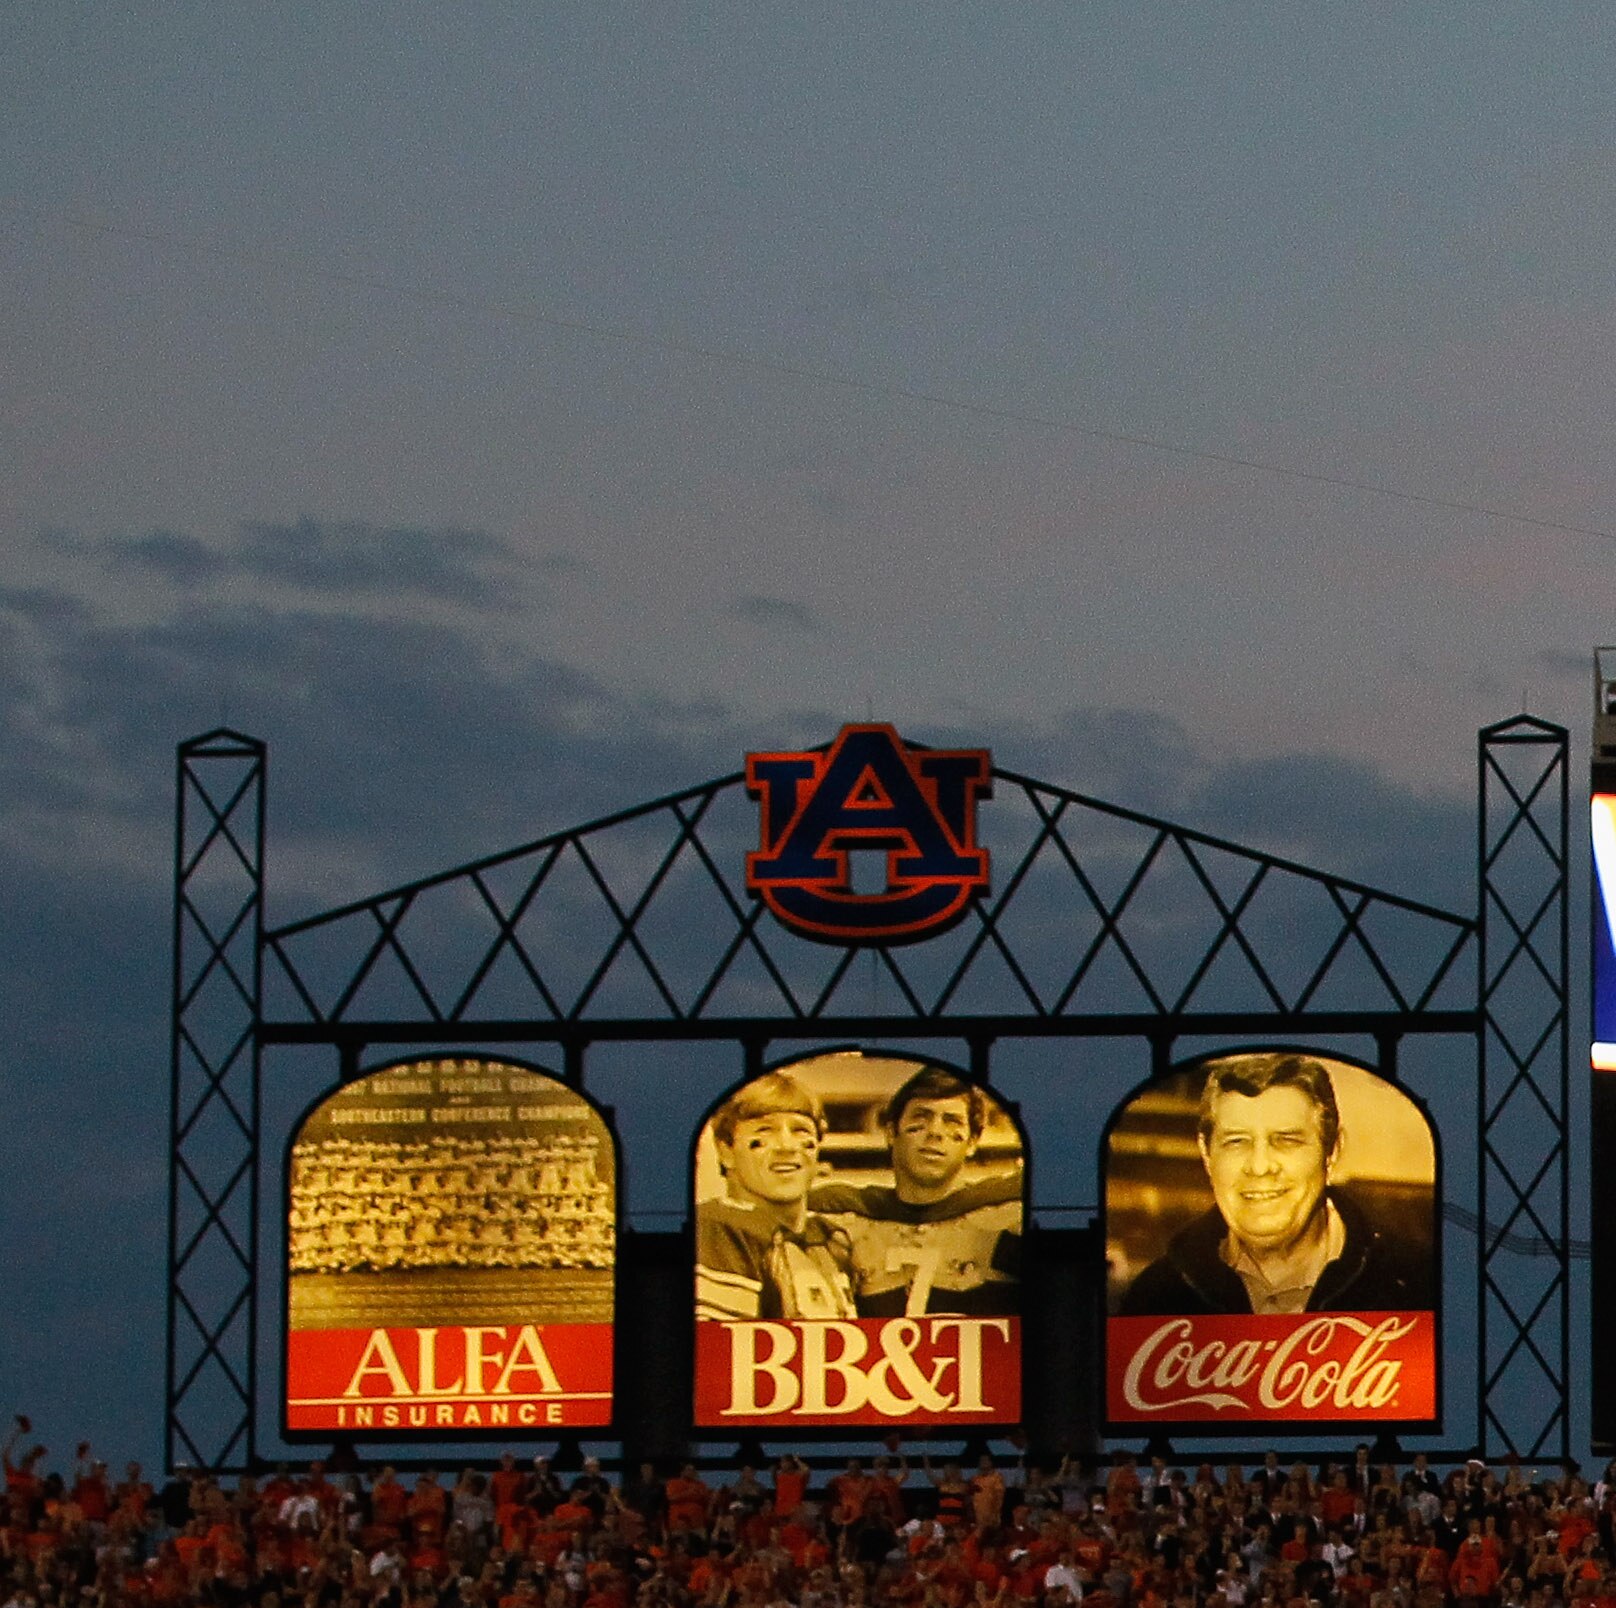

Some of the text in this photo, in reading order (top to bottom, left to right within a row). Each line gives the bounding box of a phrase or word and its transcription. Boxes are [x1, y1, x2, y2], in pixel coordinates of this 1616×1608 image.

[343, 1327, 564, 1398] ALFA
[720, 1317, 1010, 1417] BB&T
[1122, 1315, 1418, 1412] Coca-Cola
[337, 1403, 565, 1427] INSURANCE
